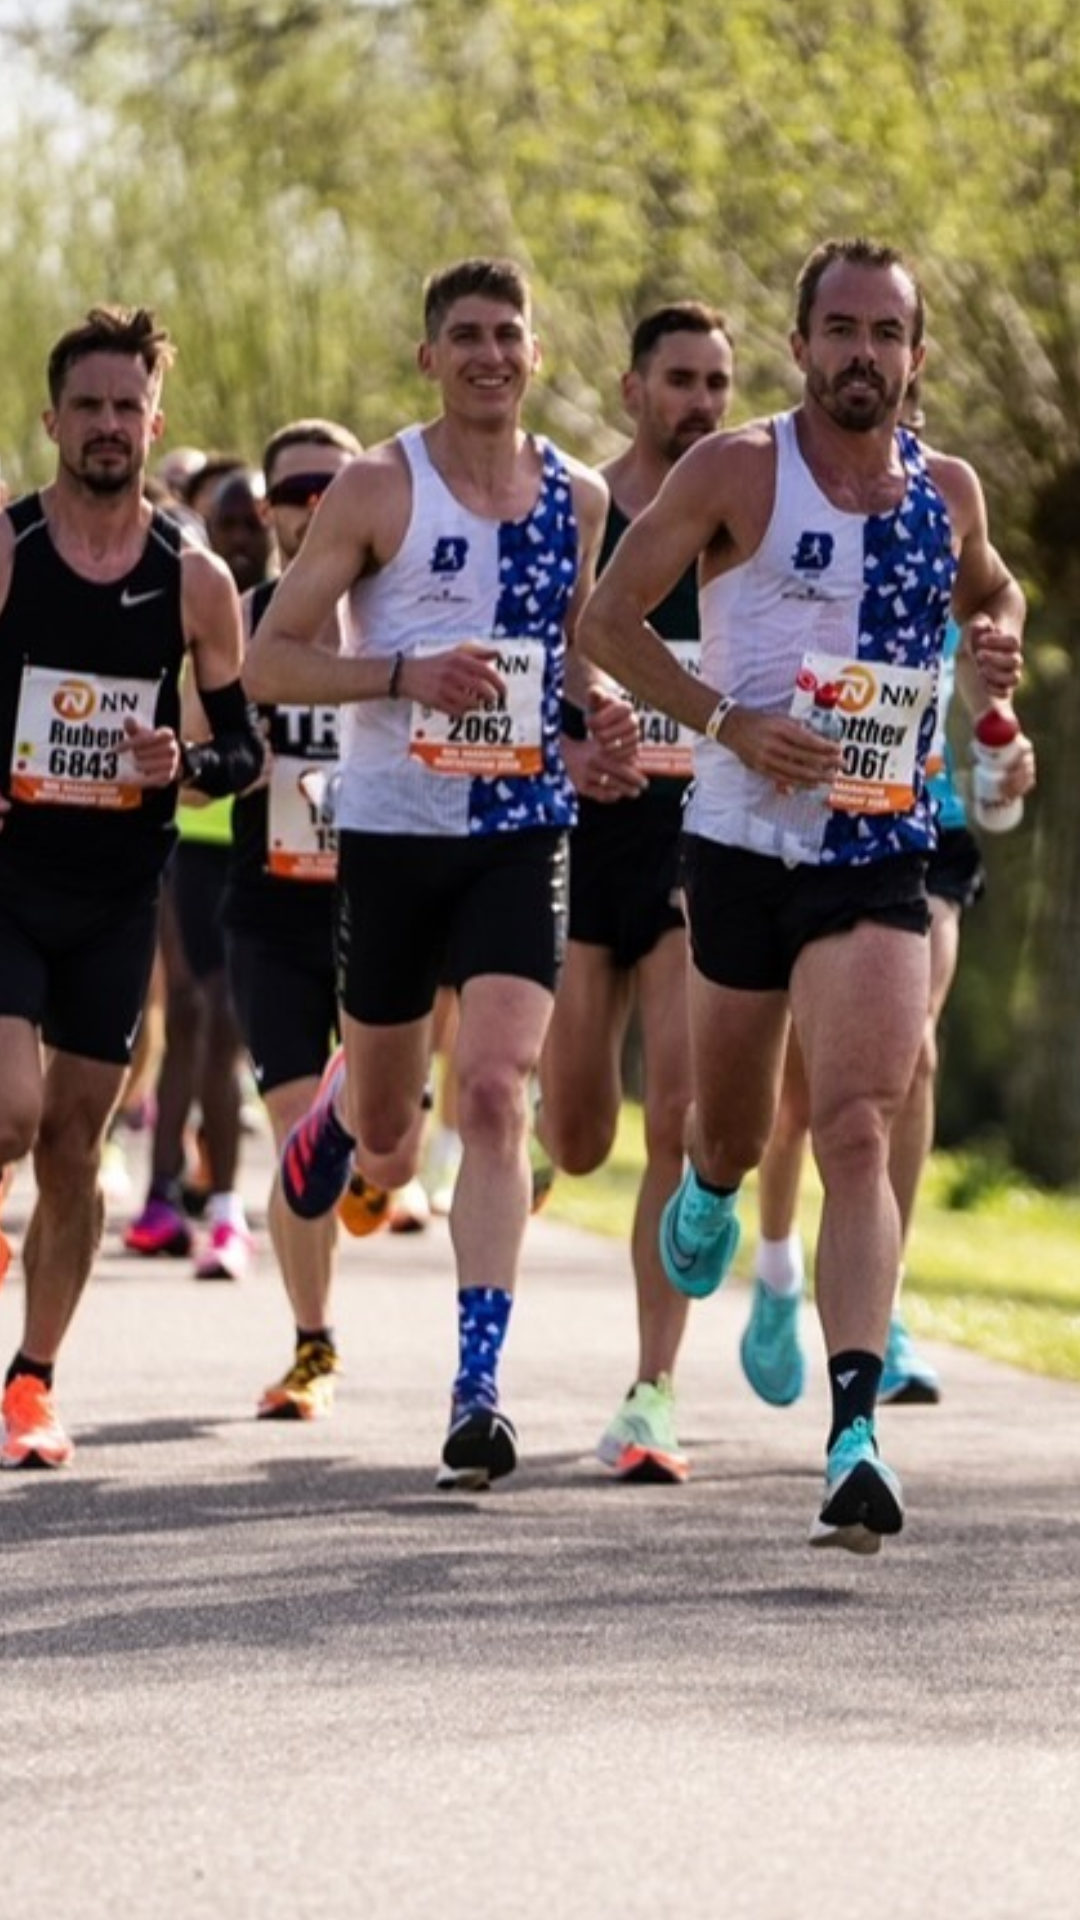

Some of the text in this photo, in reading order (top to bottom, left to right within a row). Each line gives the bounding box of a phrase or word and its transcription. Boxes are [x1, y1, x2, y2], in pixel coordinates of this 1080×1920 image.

[100, 692, 139, 712] NN
[881, 683, 919, 707] NN
[448, 716, 513, 744] 2062
[49, 749, 118, 779] 6843
[842, 745, 889, 780] 061
